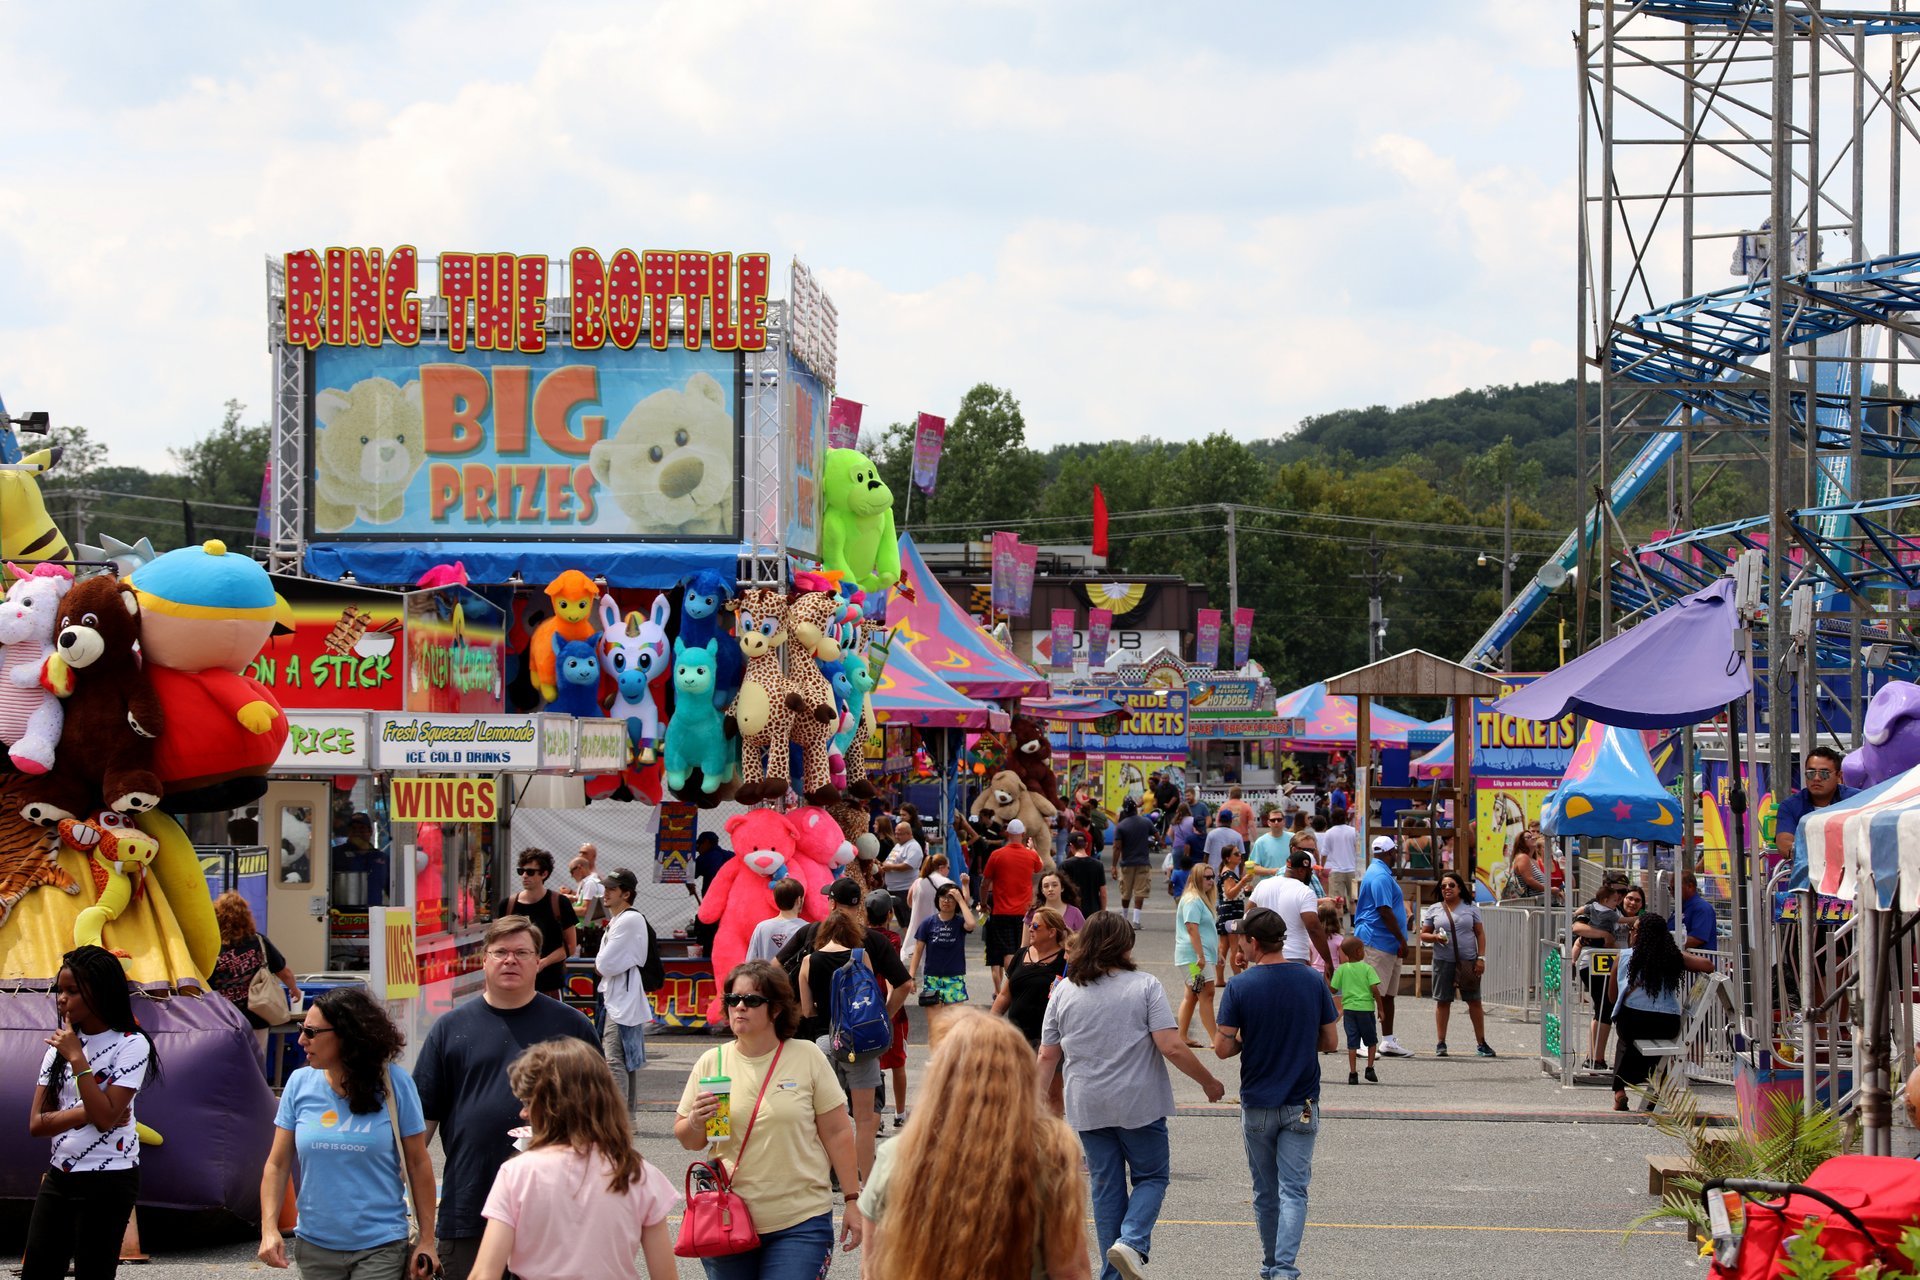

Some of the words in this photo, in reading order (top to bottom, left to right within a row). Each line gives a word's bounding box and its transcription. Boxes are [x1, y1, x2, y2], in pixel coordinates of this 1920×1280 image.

[284, 245, 421, 350] RING
[440, 252, 548, 352] THE
[570, 248, 770, 351] BOTTLE
[419, 362, 606, 457] BIG
[429, 463, 599, 525] PRIZES
[286, 654, 302, 688] A
[311, 654, 393, 688] STICK
[1127, 694, 1168, 708] RIDE
[1207, 695, 1225, 706] HOT
[1225, 695, 1249, 706] DOGS
[383, 720, 418, 742] Fresh
[418, 719, 477, 746] Squeezed
[478, 719, 535, 743] Lemonade
[1122, 712, 1185, 735] ICKETS
[1477, 712, 1576, 748] TICKETS
[289, 724, 355, 755] RICE
[406, 752, 426, 763] ICE
[430, 752, 462, 763] COLD
[466, 751, 511, 763] DRINKS
[393, 782, 495, 819] WINGS
[340, 1144, 367, 1152] GOOD
